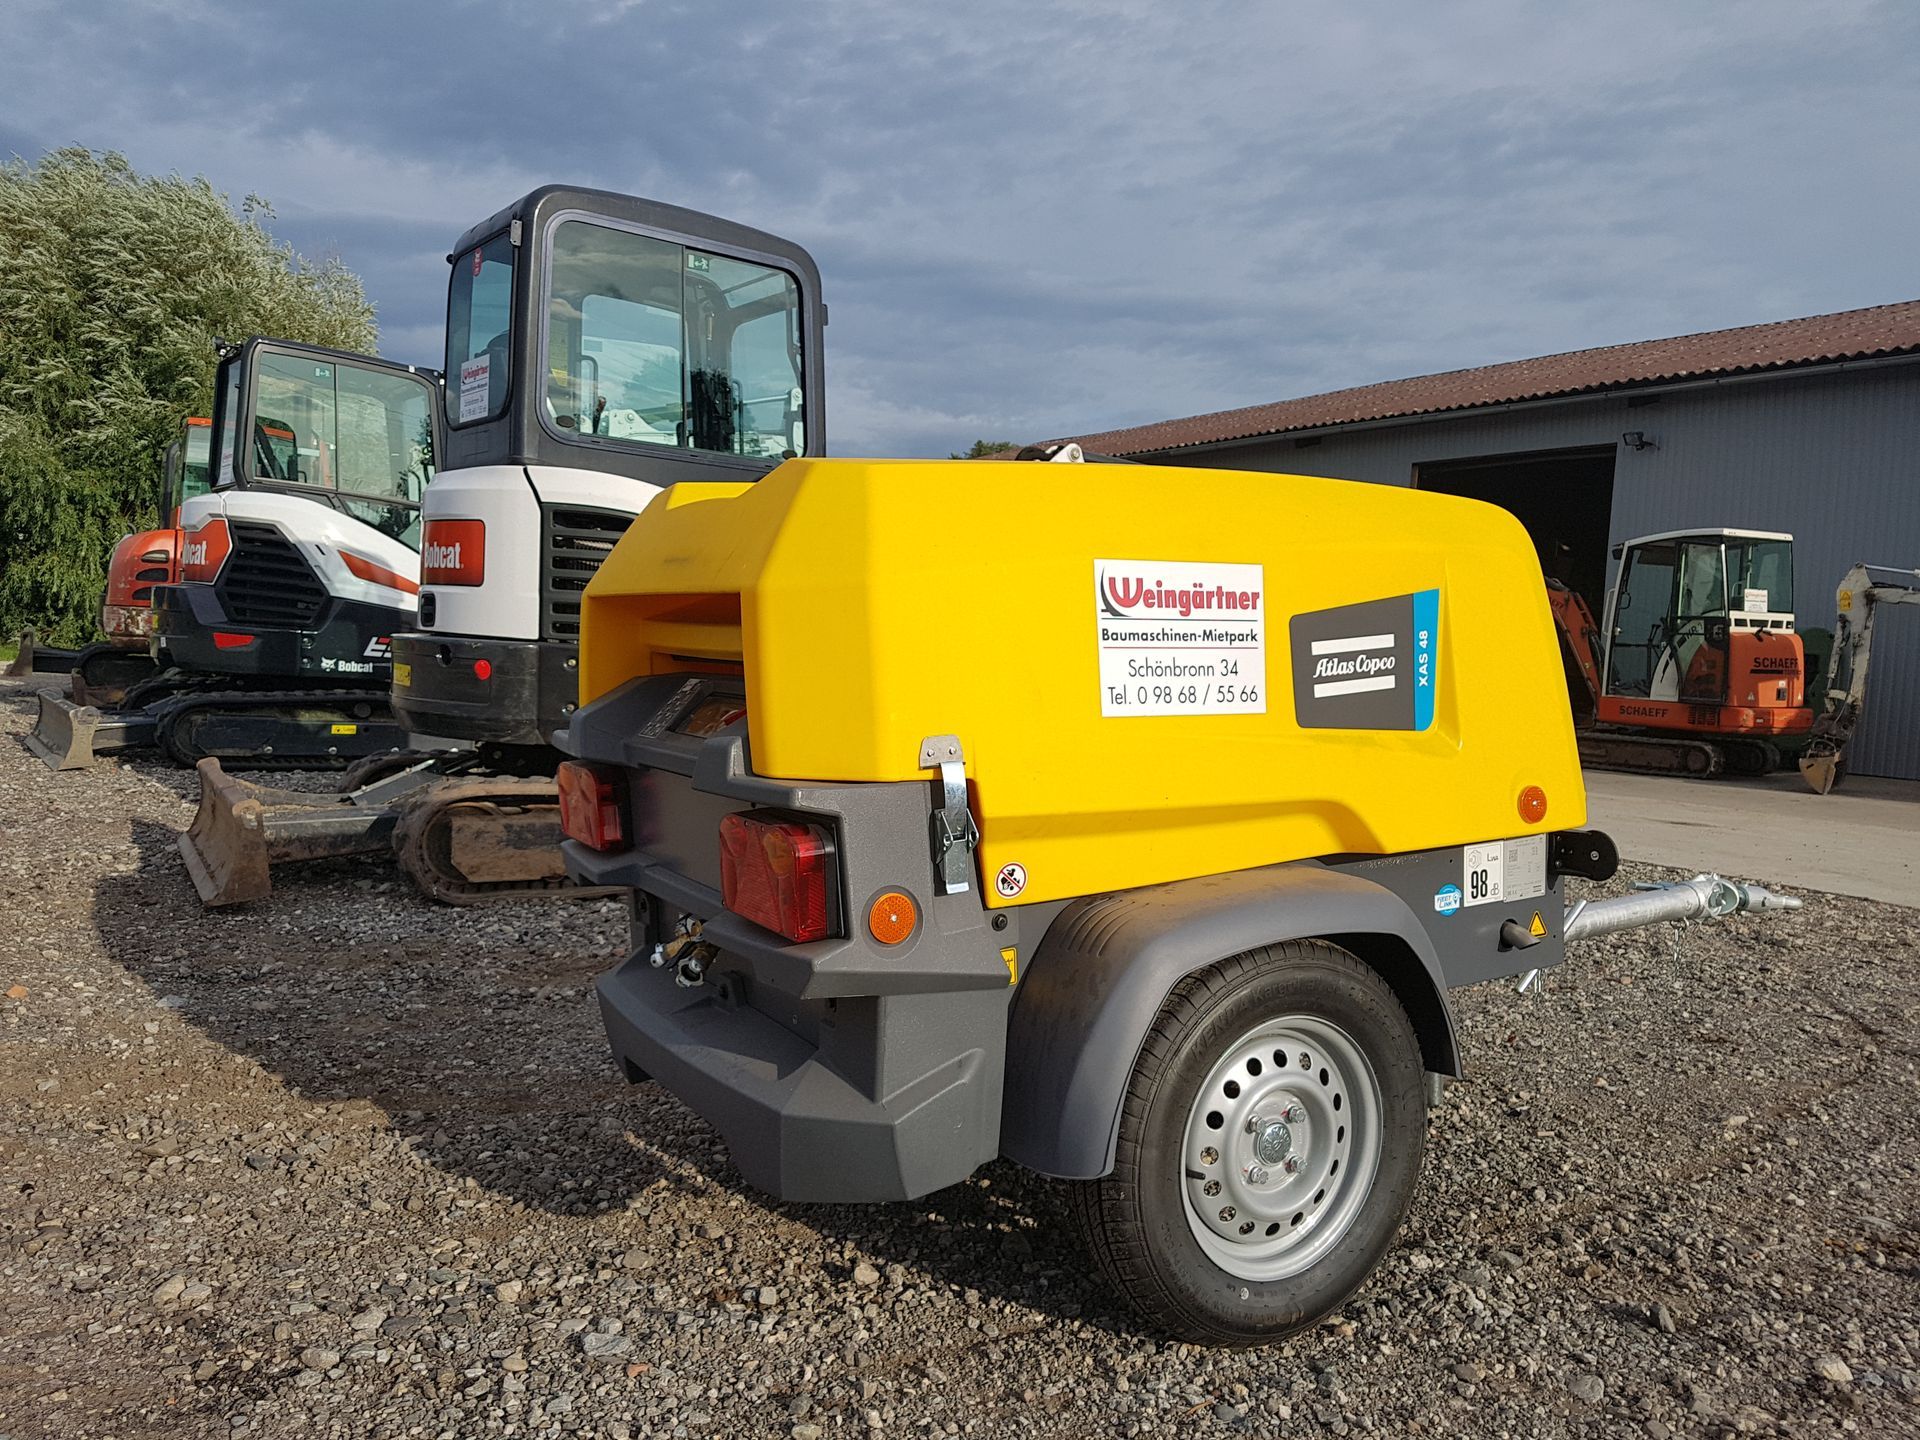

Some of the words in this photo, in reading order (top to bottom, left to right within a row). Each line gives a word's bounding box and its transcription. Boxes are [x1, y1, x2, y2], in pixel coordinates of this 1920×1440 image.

[424, 541, 461, 569] Bobcat
[1108, 576, 1260, 617] Weingärtner
[1102, 627, 1258, 646] Baumaschinen-Mietpark
[1418, 630, 1429, 649] 48
[338, 661, 373, 673] Bobcat
[1128, 656, 1215, 677] Schönbronn
[1220, 658, 1239, 677] 34
[1418, 652, 1429, 687] XAS
[1753, 657, 1799, 669] SCHAEFF
[1107, 684, 1132, 705] Tel.
[1137, 685, 1148, 705] 0
[1153, 685, 1172, 704] 98
[1178, 685, 1197, 704] 68
[1216, 685, 1235, 703] 55
[1239, 685, 1258, 703] 66
[1619, 705, 1668, 718] SCHAEFF
[1471, 868, 1488, 900] 98
[1490, 882, 1500, 896] dB
